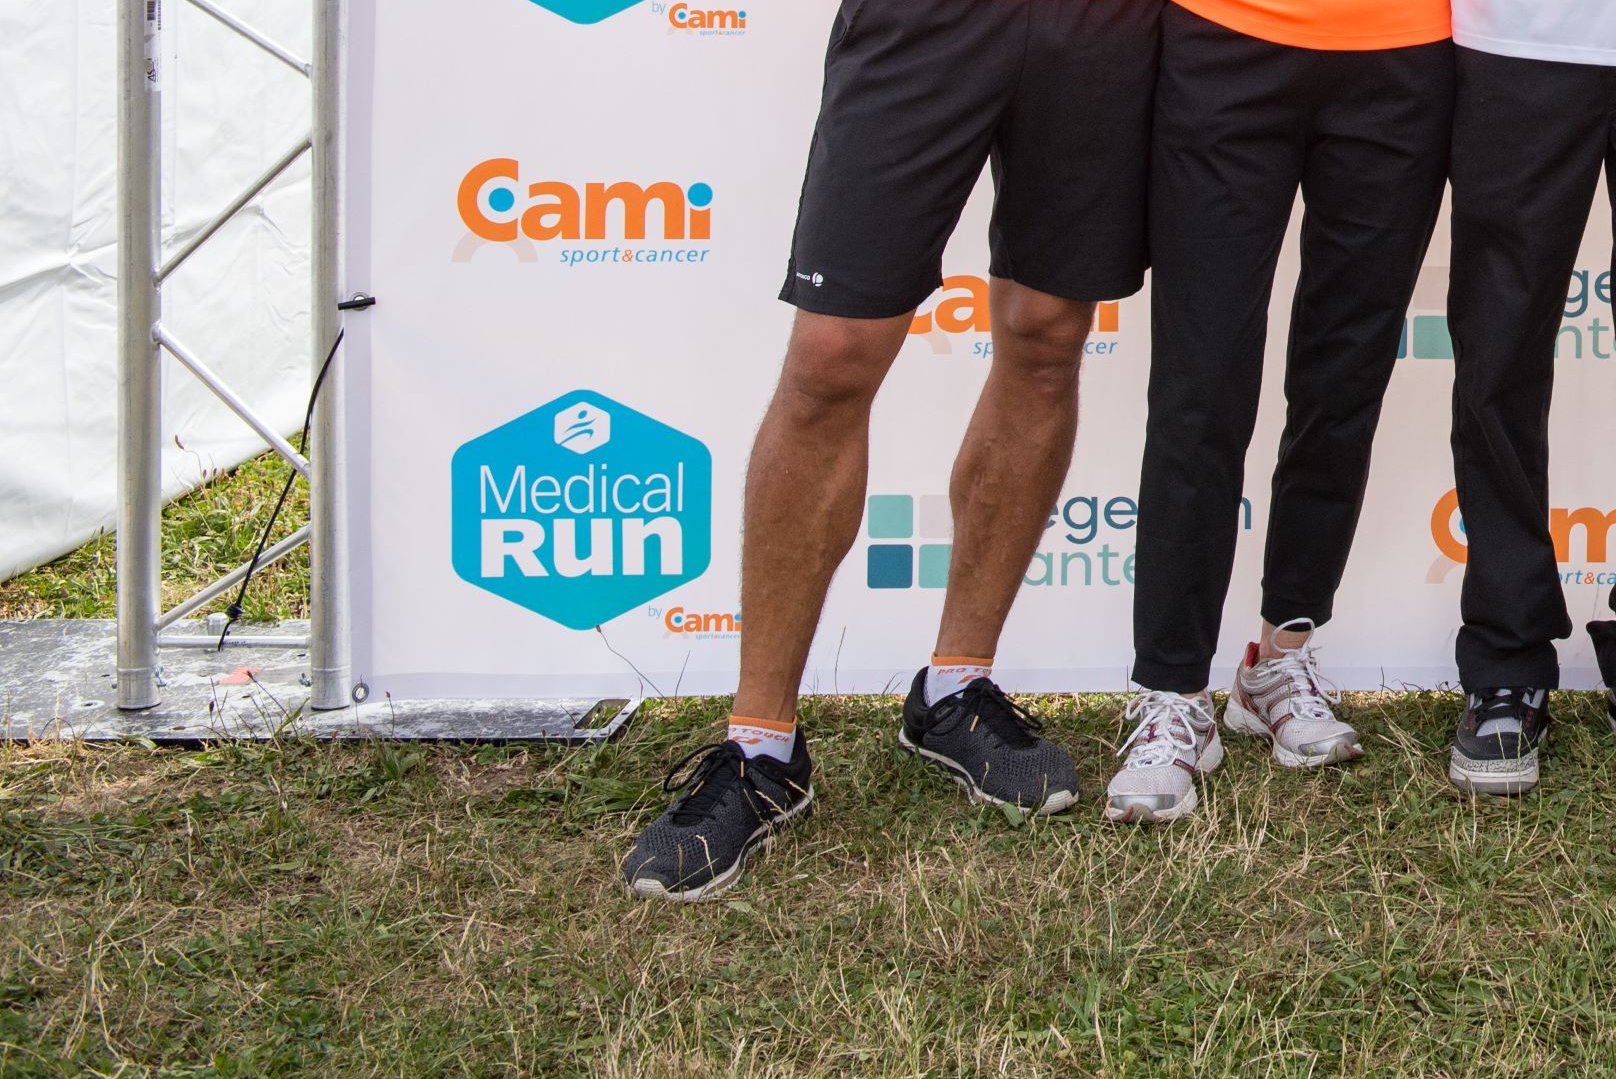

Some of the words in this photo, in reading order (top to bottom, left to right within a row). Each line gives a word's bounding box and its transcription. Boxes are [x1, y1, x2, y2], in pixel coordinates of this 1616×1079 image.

[651, 1, 666, 15] by
[668, 2, 746, 29] Cami
[457, 158, 713, 242] Cami
[560, 246, 710, 266] sport&cancer
[479, 462, 683, 513] Medical
[480, 515, 683, 578] Run
[648, 605, 662, 620] by
